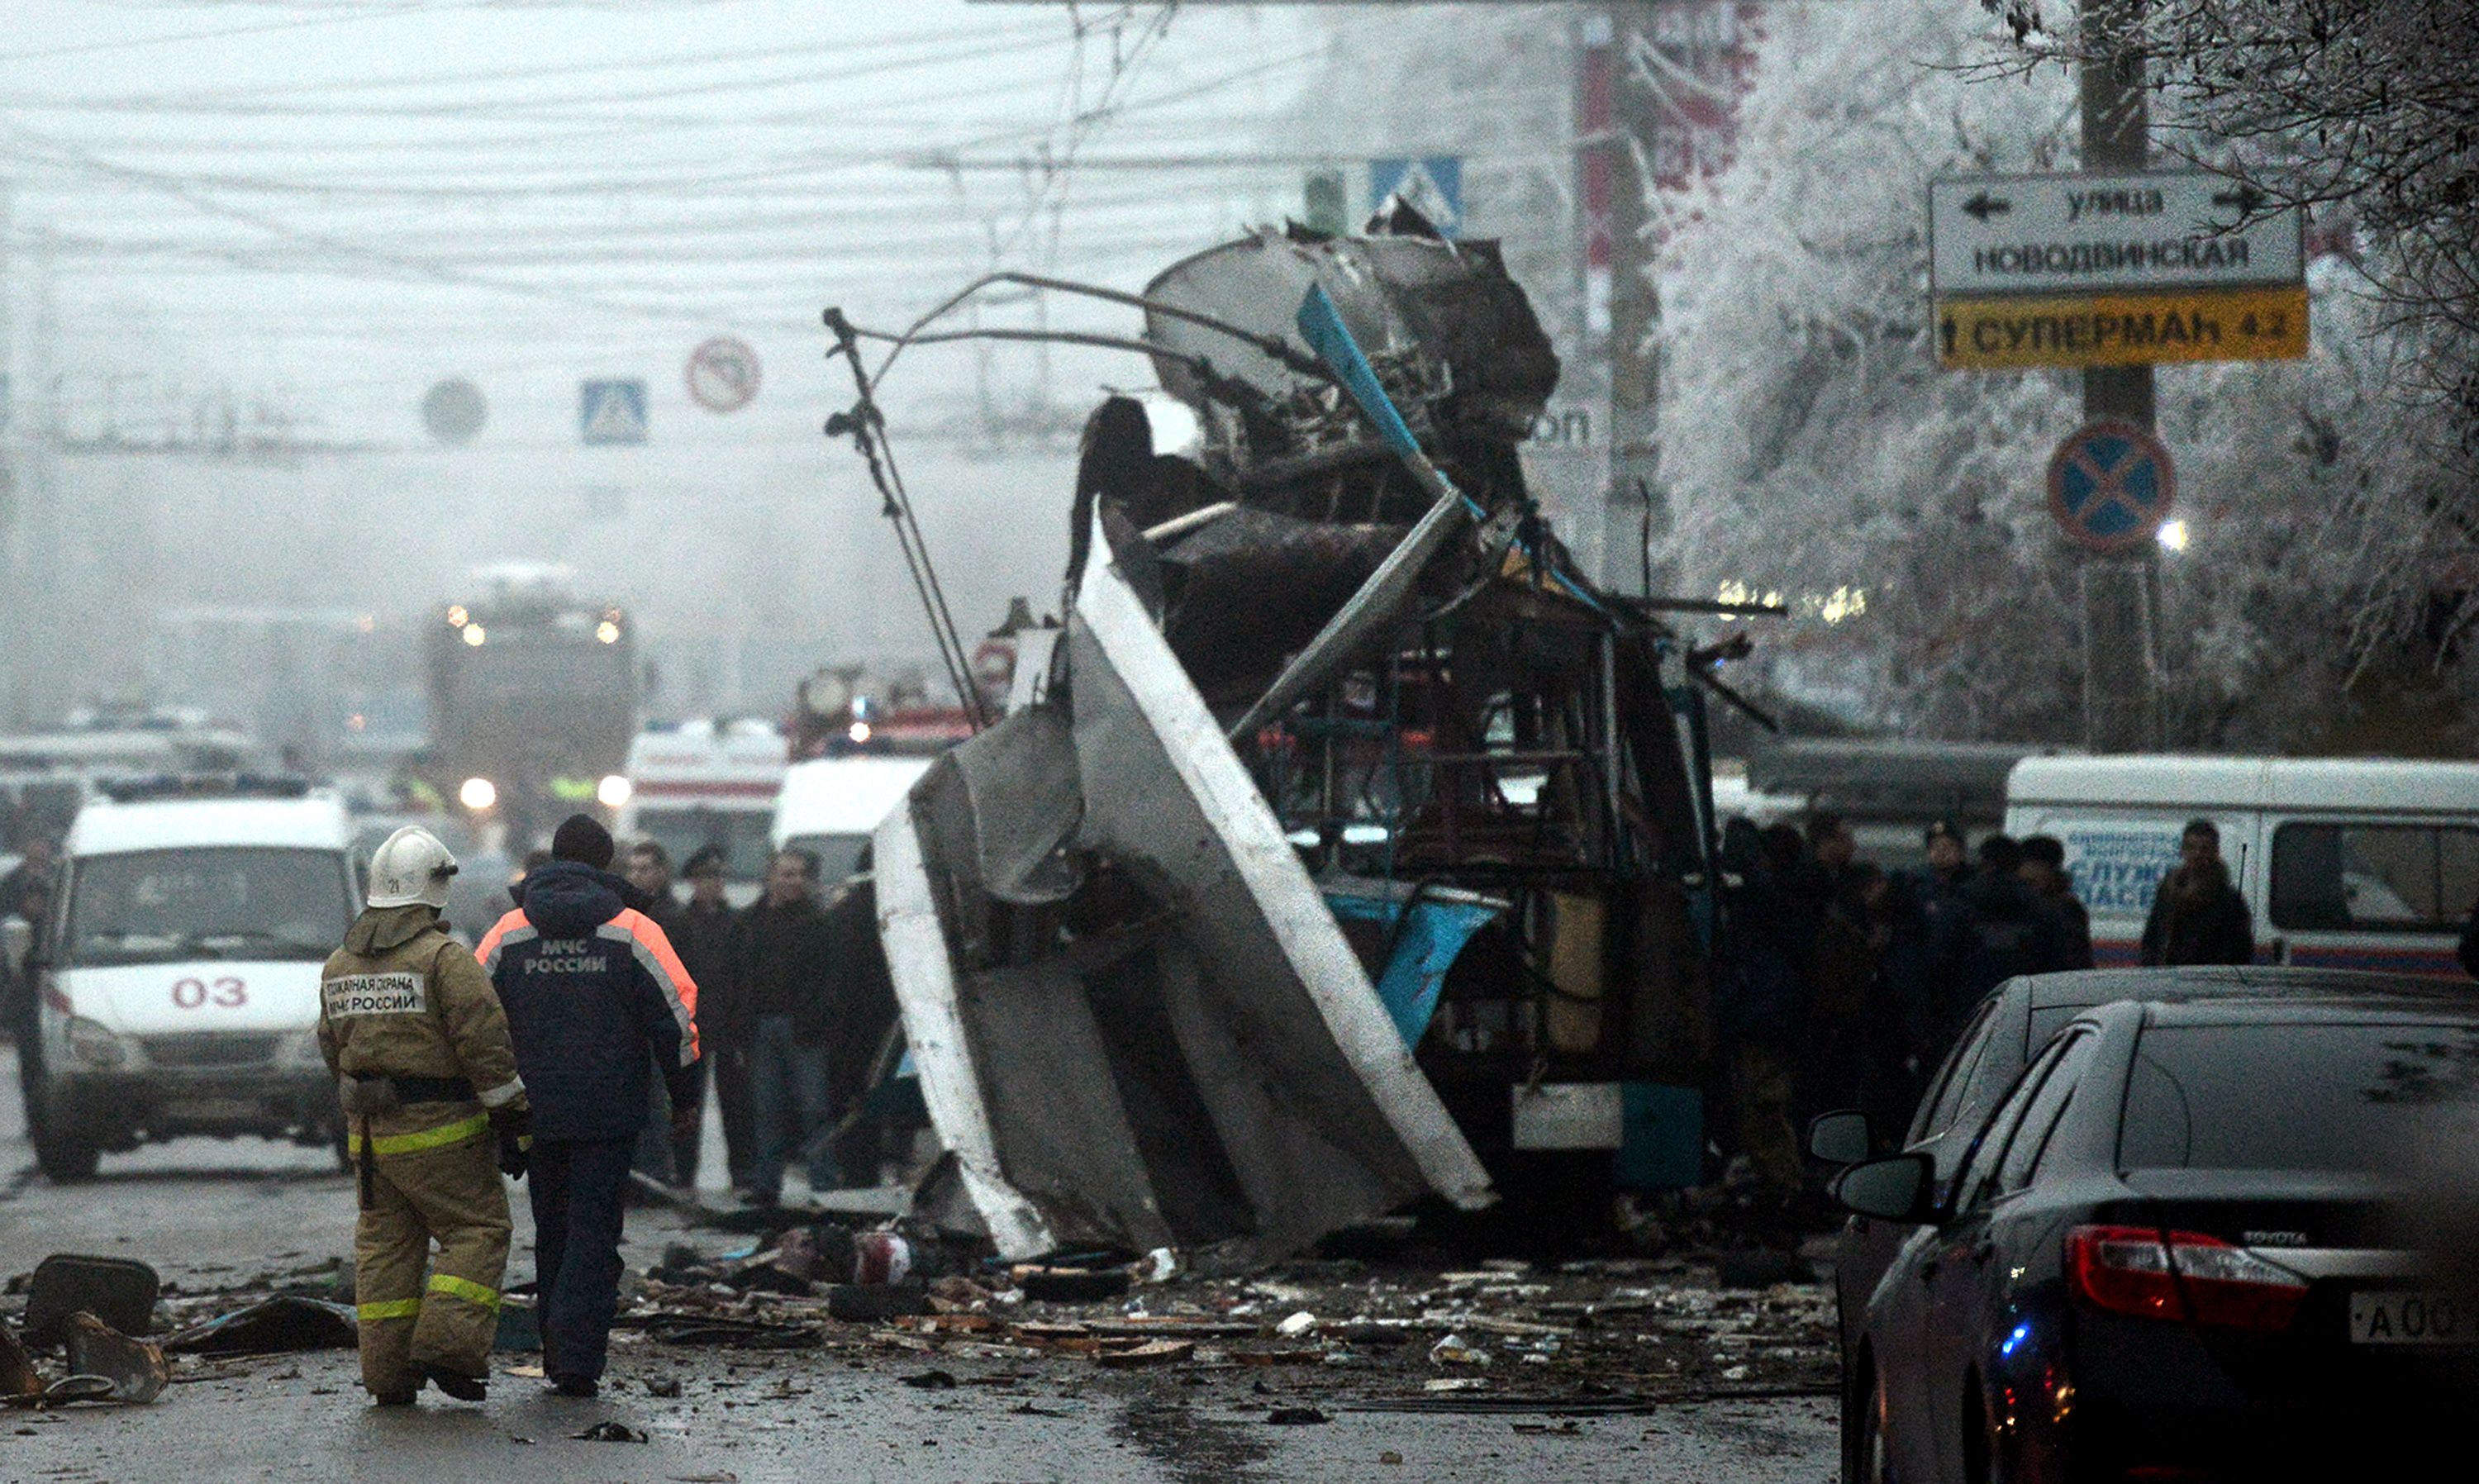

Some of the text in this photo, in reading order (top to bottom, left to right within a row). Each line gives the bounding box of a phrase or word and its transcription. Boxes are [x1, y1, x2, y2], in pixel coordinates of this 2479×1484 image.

[2067, 188, 2164, 222] улица
[1974, 236, 2250, 275] НОВОДВИНСКАЯ
[541, 939, 588, 954] МЧС
[525, 956, 607, 974] РОССИИ
[172, 977, 247, 1008] 03
[351, 996, 416, 1011] РОССИИ
[2243, 1230, 2306, 1243] TOYOTA
